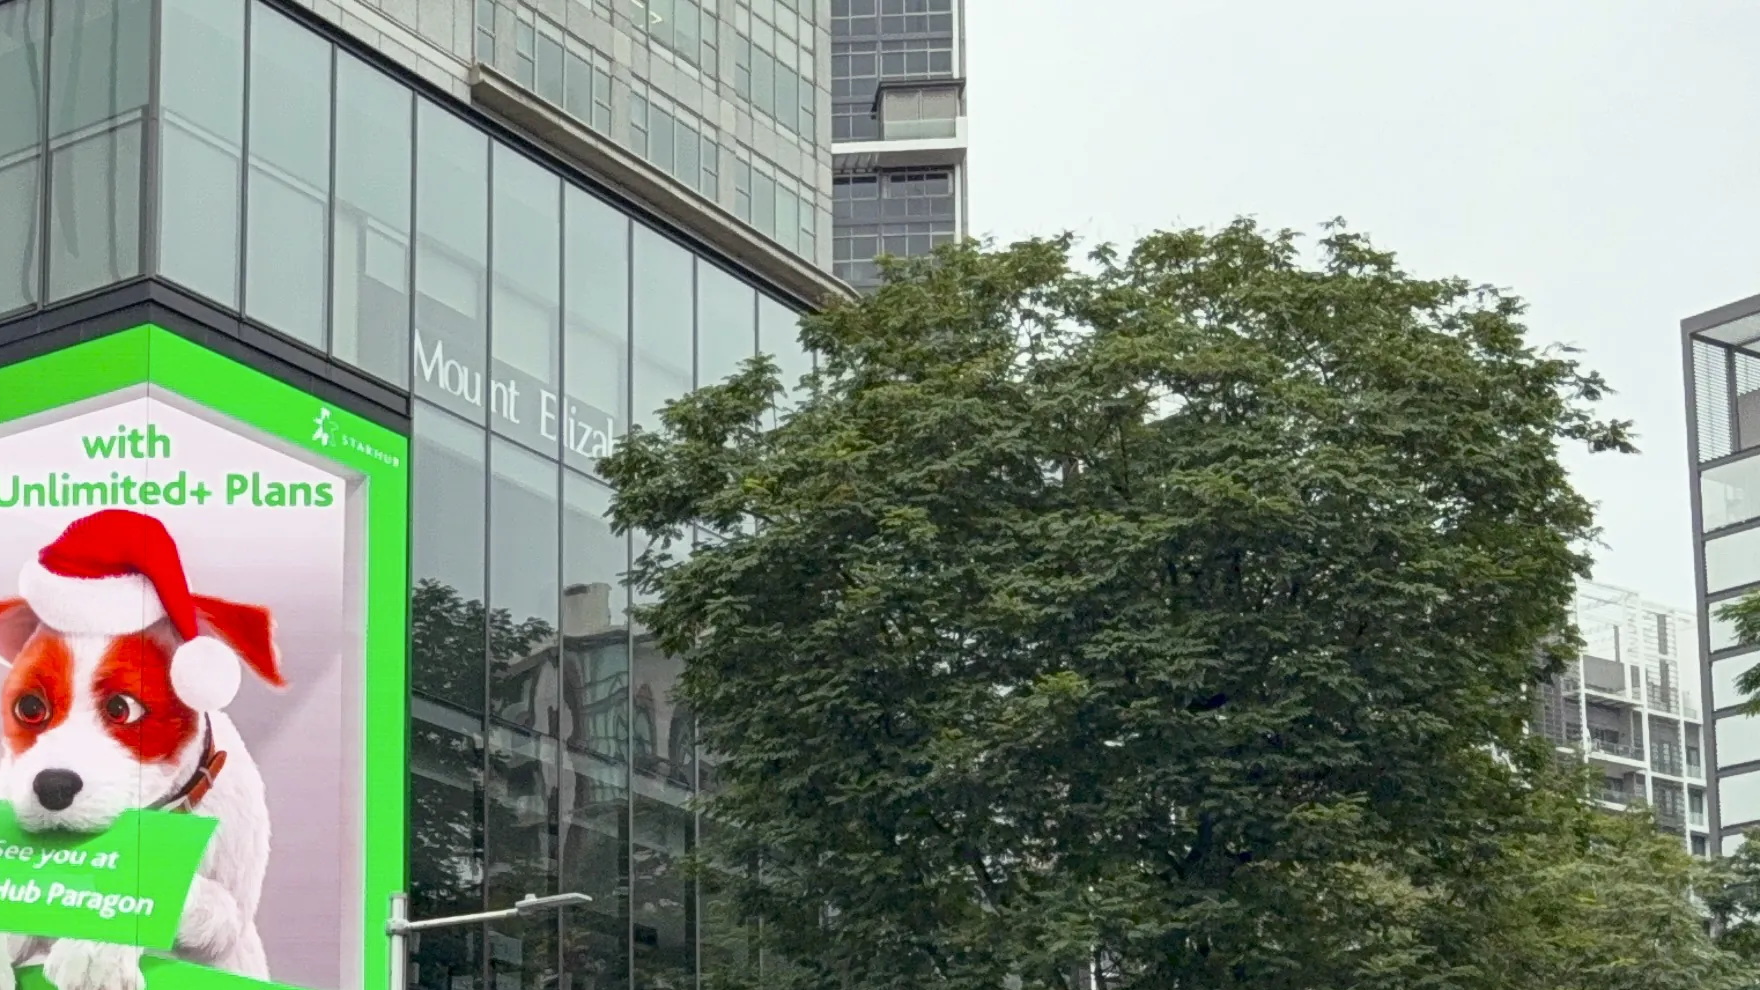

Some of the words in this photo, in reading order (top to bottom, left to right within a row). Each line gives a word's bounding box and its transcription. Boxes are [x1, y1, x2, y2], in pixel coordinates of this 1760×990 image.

[414, 327, 520, 424] Mount
[82, 423, 171, 459] with
[342, 434, 400, 468] STARHUB
[225, 472, 334, 508] Plans
[33, 848, 87, 870] you
[91, 849, 120, 870] at
[46, 881, 154, 919] Paragon
